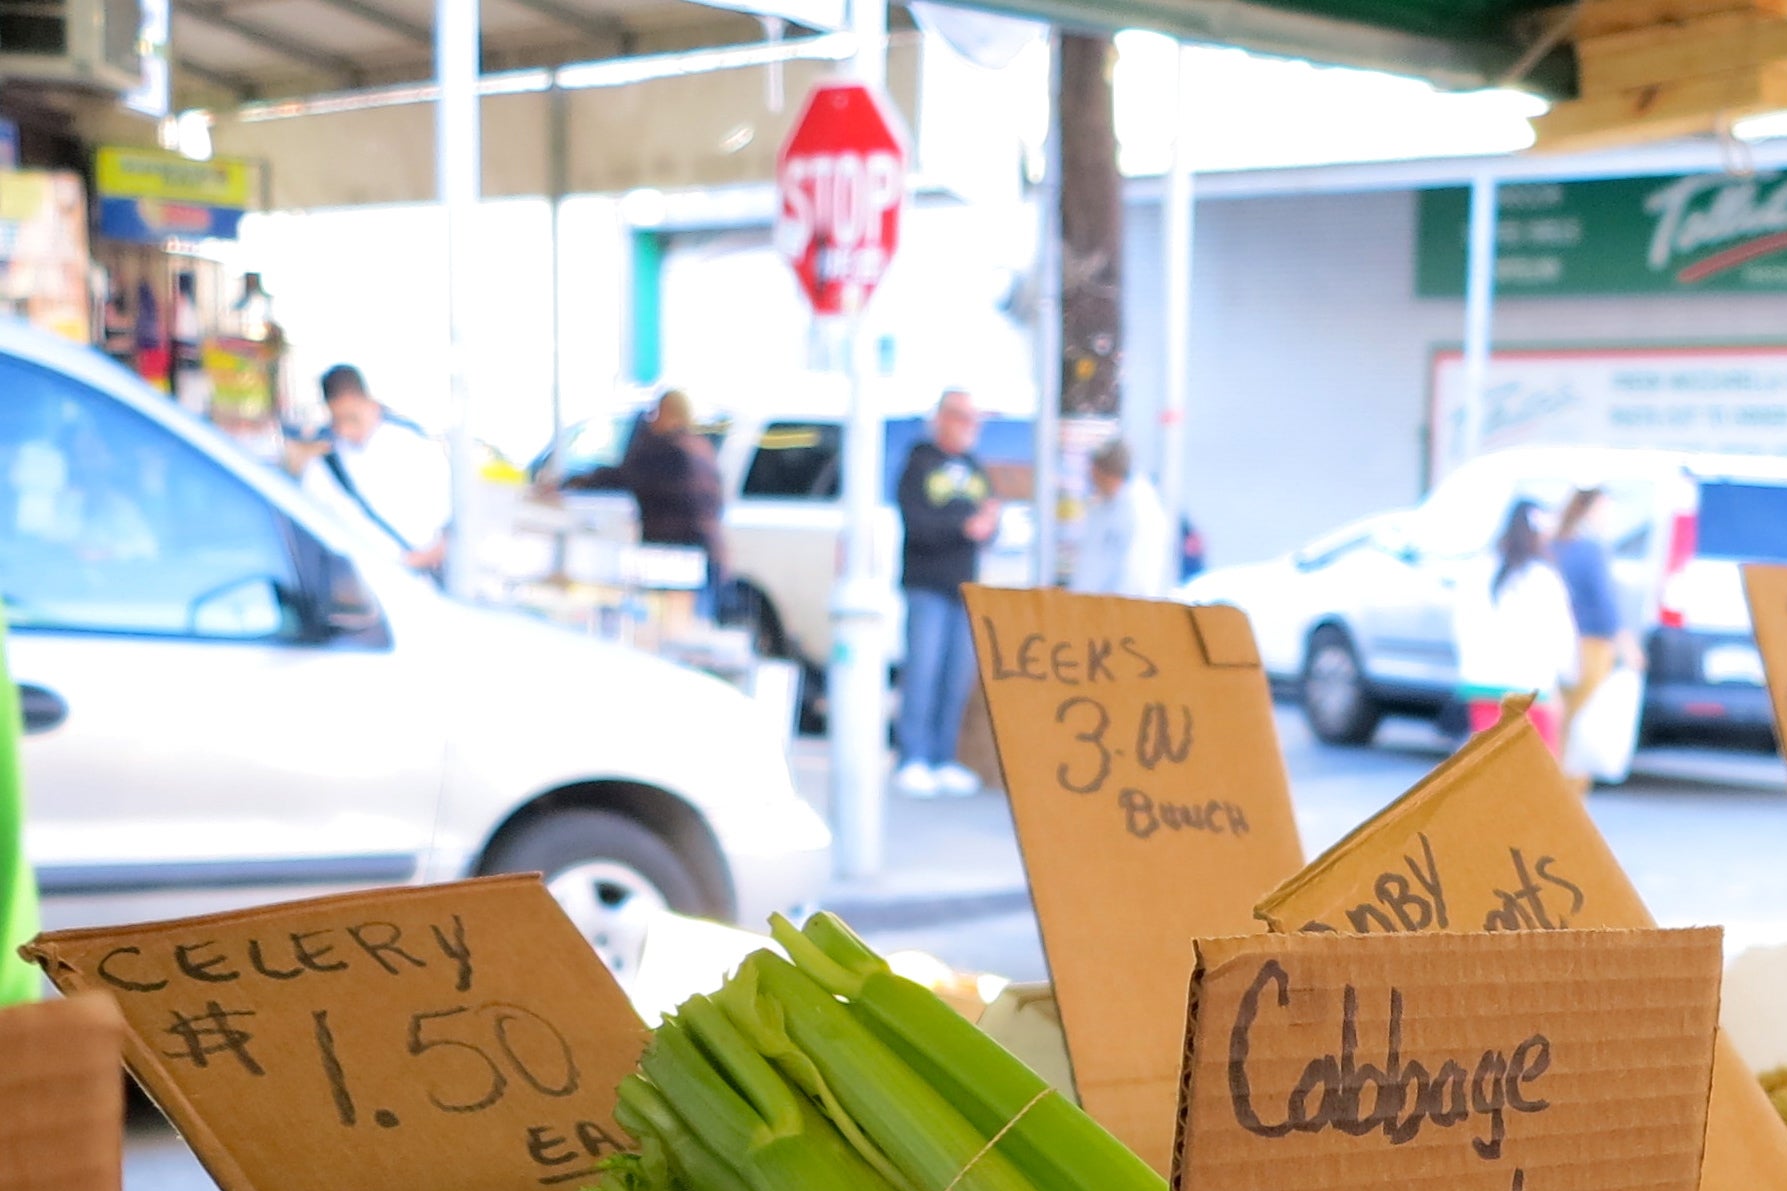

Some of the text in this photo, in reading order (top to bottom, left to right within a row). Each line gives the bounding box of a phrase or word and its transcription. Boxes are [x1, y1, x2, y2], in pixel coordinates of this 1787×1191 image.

[776, 153, 903, 260] STOP
[982, 613, 1160, 687] LEEKS
[97, 914, 473, 993] CELERY
[1228, 958, 1551, 1160] Cabbage
